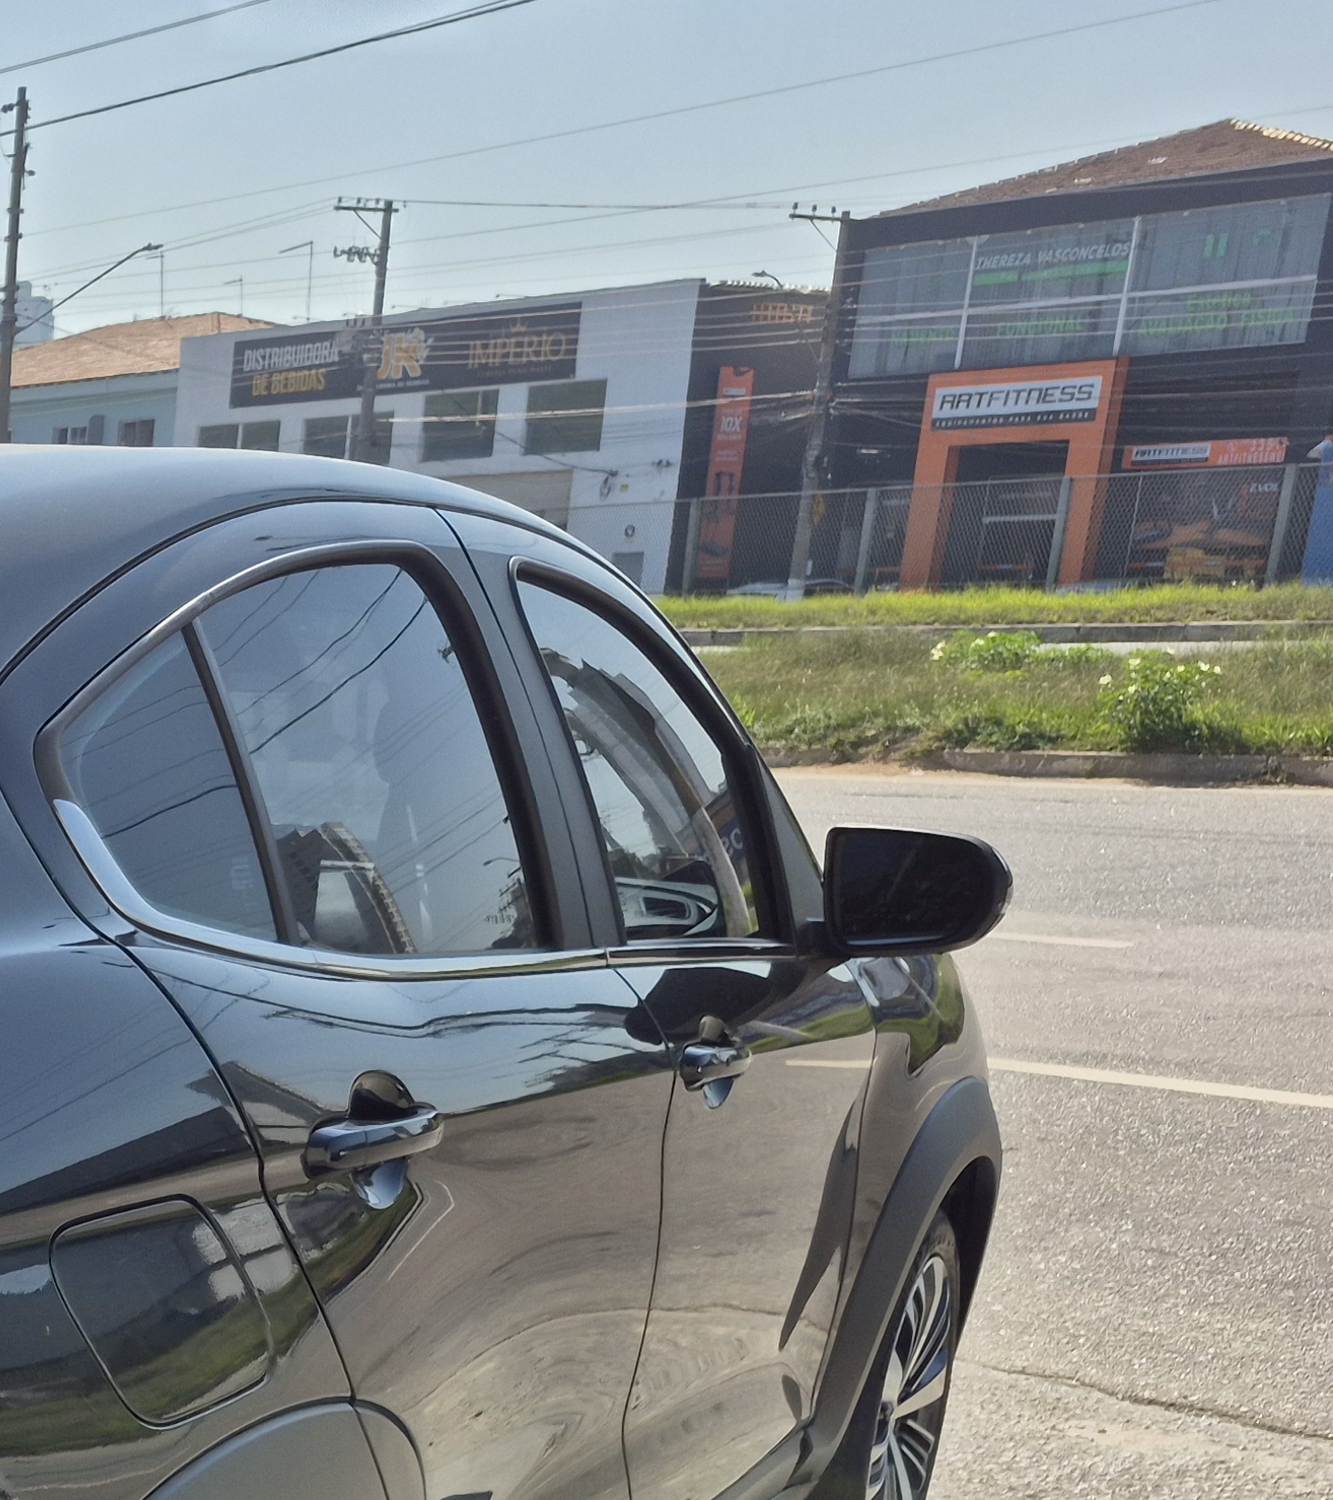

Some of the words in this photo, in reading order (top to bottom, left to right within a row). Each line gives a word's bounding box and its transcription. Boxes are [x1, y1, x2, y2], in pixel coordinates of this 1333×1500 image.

[1038, 241, 1131, 263] VASCONCELOS
[243, 340, 339, 373] DISTRIBUIDORA
[251, 374, 268, 397] DE
[271, 367, 326, 395] BEBIDAS
[939, 383, 1095, 411] ARTFITNESS
